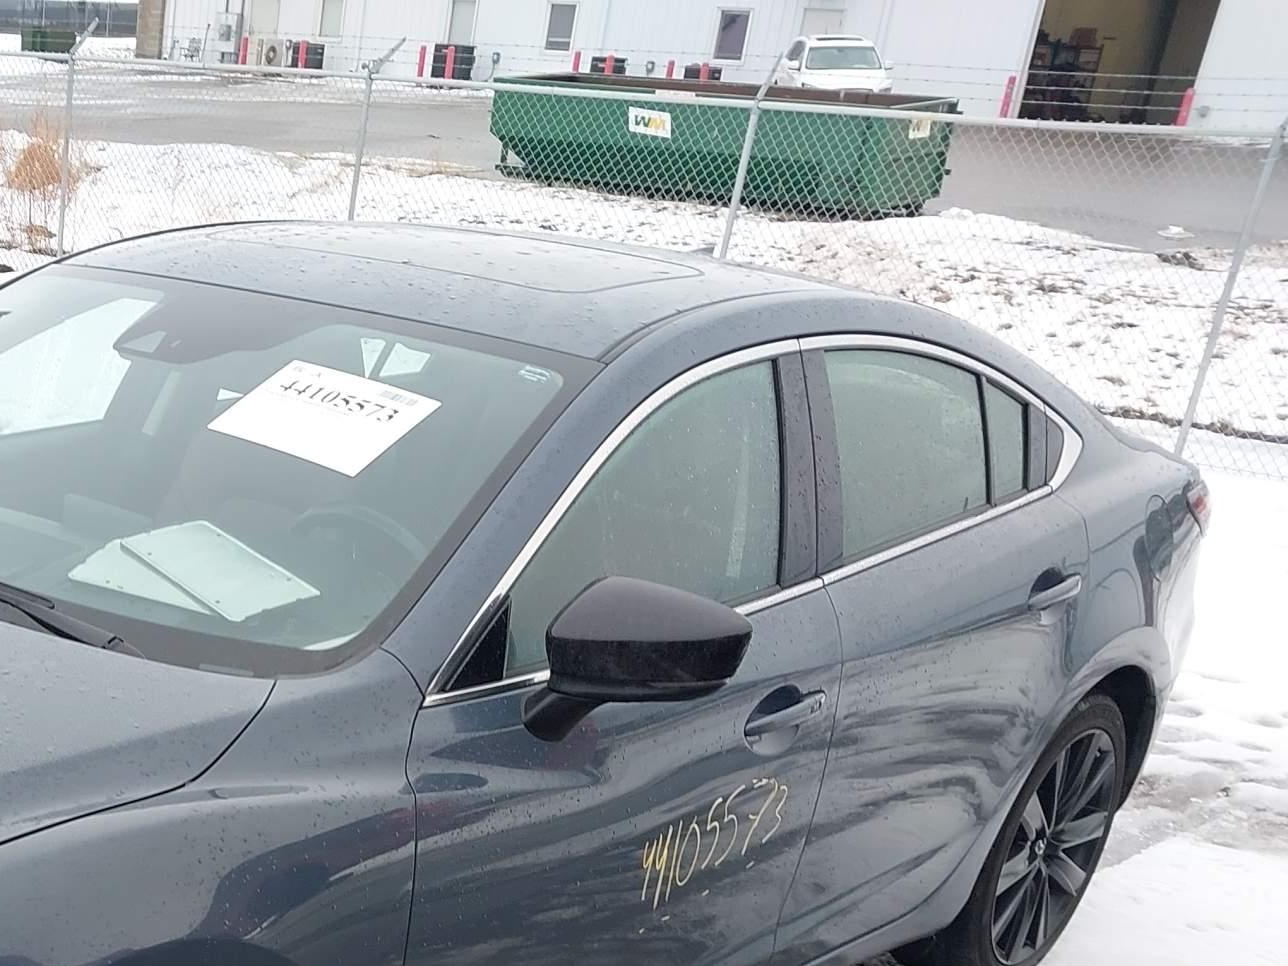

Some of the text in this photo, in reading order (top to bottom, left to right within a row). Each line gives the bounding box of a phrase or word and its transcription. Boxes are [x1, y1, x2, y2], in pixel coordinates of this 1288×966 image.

[634, 114, 665, 130] WM
[279, 380, 400, 422] 44105573
[641, 777, 789, 911] 44105573
